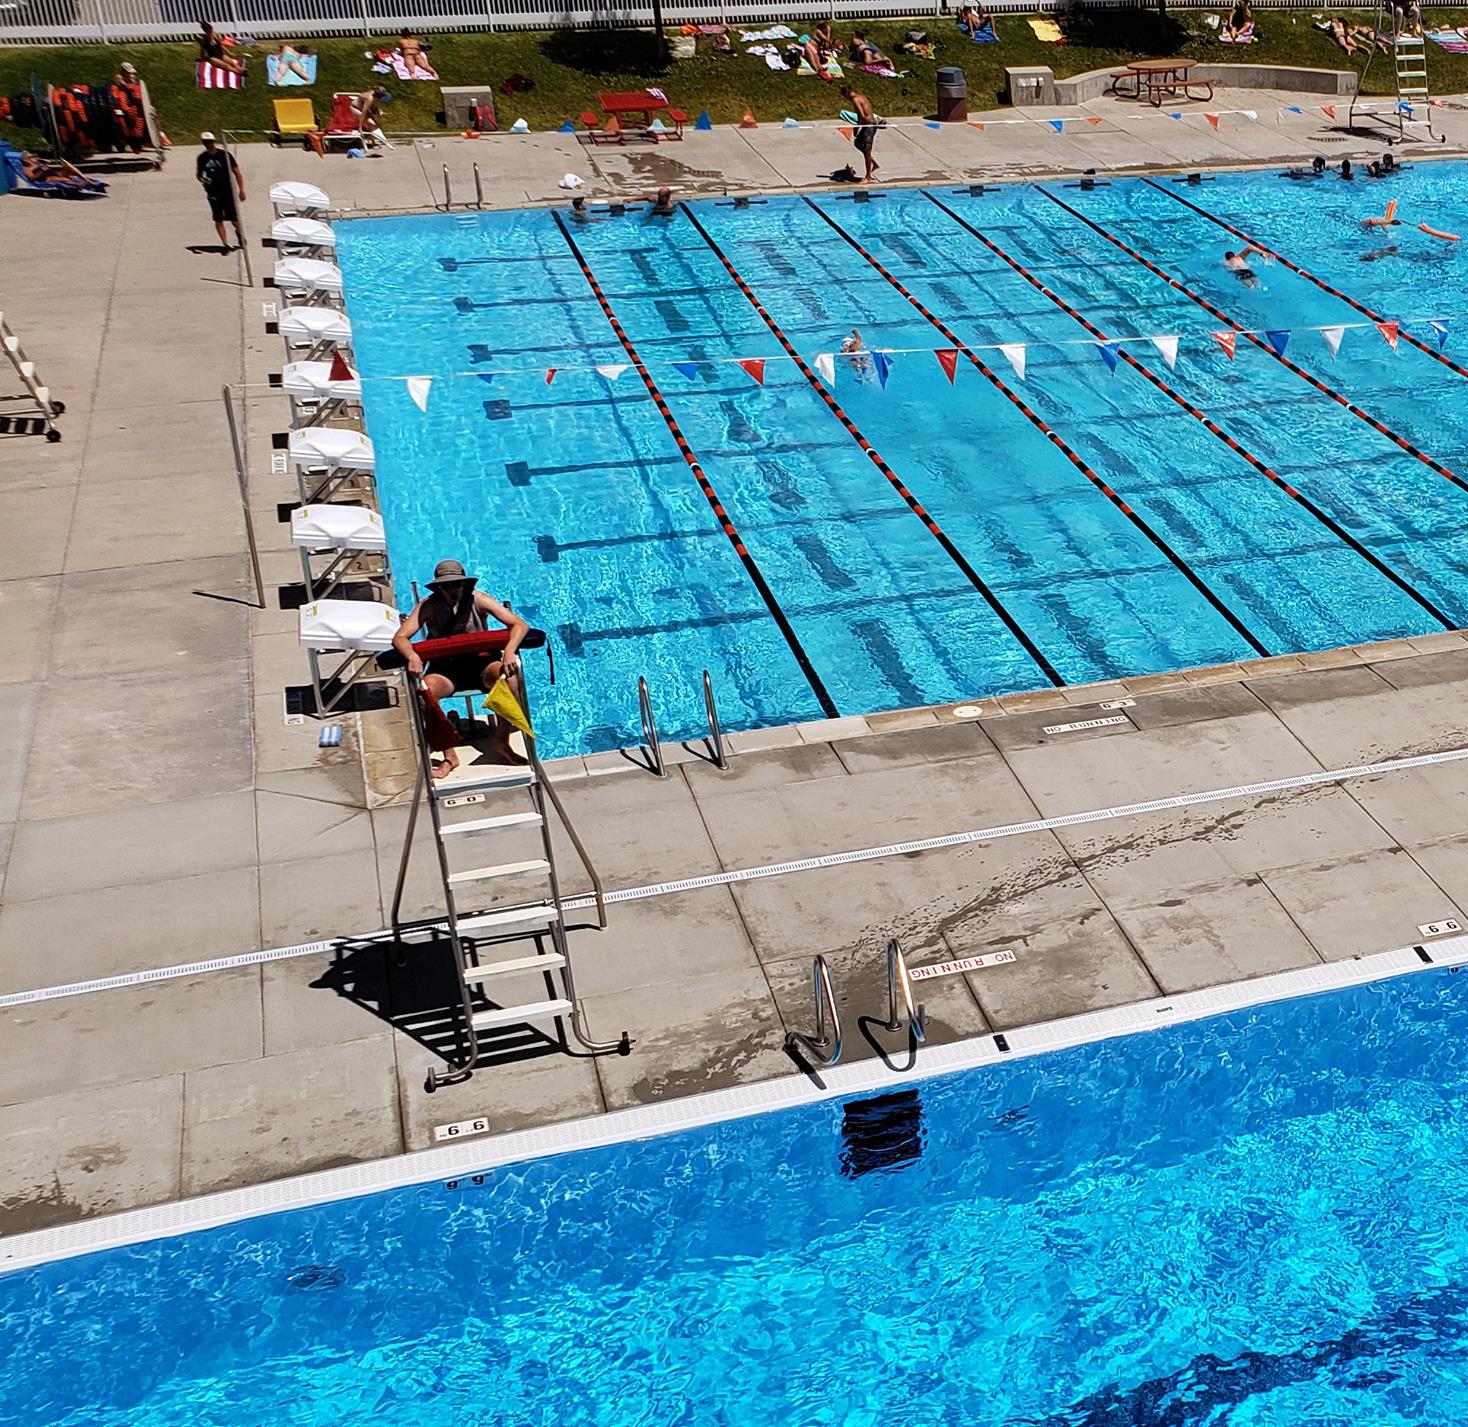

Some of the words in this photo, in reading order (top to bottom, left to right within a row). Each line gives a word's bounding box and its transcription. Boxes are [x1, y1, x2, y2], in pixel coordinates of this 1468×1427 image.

[1069, 716, 1126, 729] RUNNING
[994, 952, 1014, 962] NO
[911, 958, 985, 978] RUNNING
